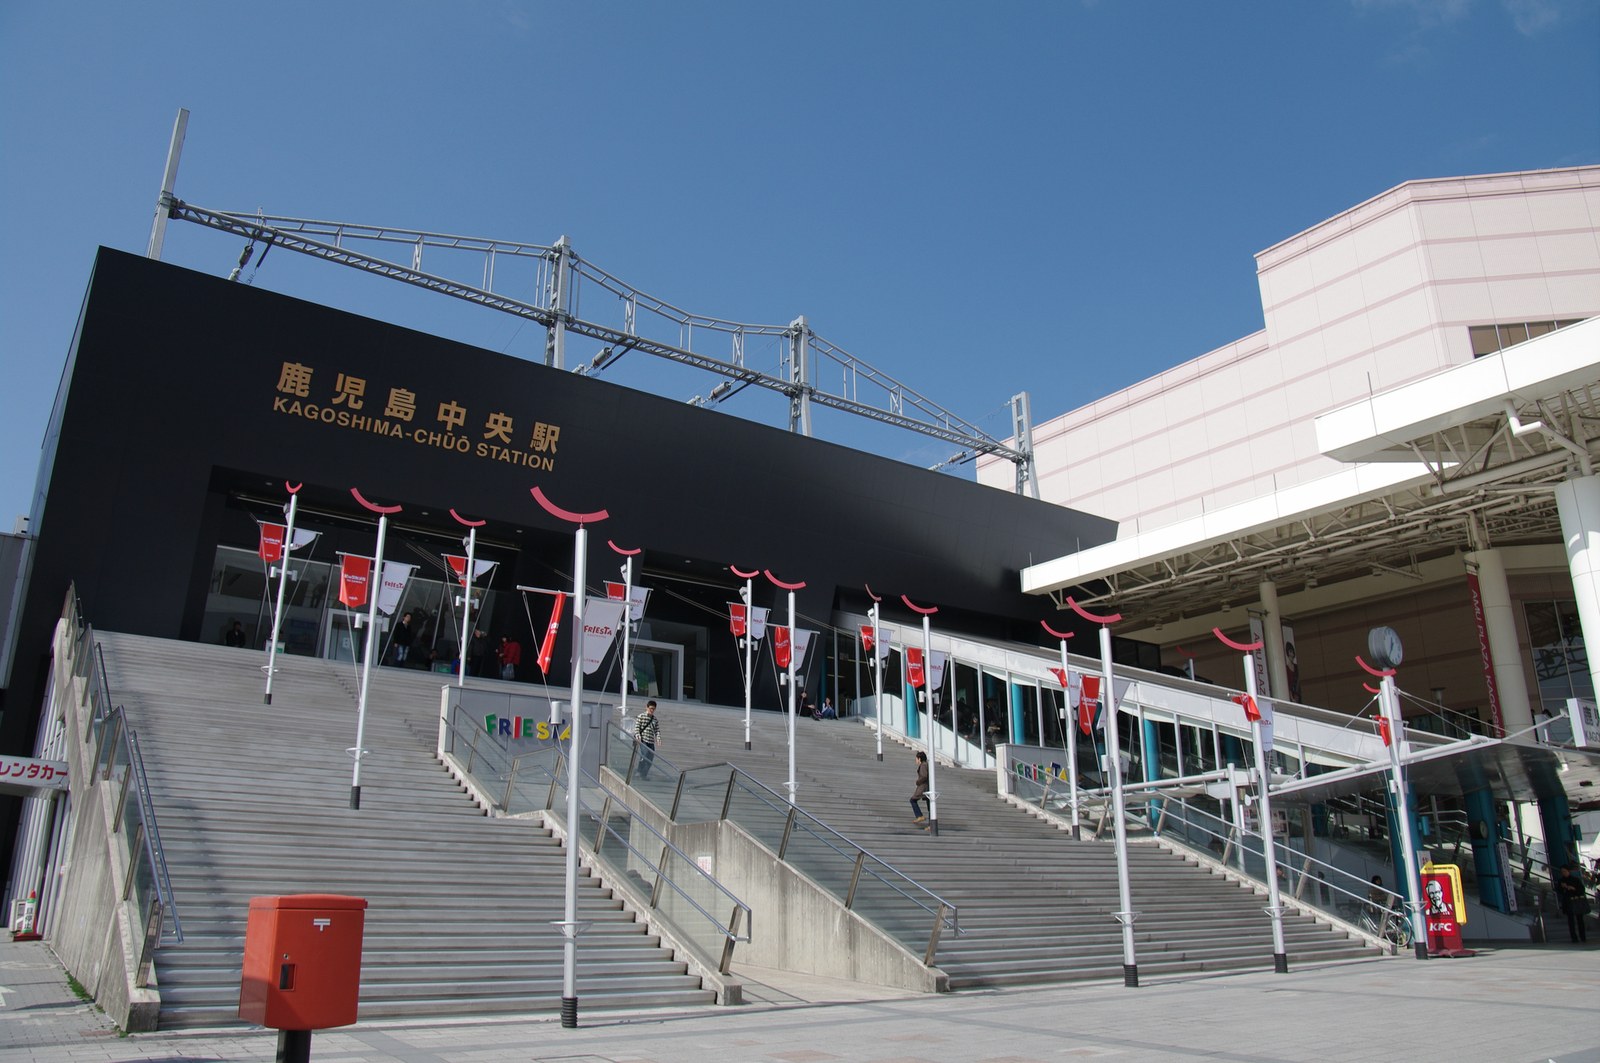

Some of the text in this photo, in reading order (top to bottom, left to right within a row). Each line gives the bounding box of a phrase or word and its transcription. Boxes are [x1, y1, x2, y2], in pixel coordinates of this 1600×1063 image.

[275, 361, 561, 454] 鹿児島中央駅
[476, 442, 555, 472] STATION
[583, 625, 613, 636] FRIESTA
[1253, 631, 1263, 661] AU
[1477, 624, 1489, 671] PLAZA
[0, 760, 68, 780] レンタカー
[1429, 922, 1452, 932] KFC
